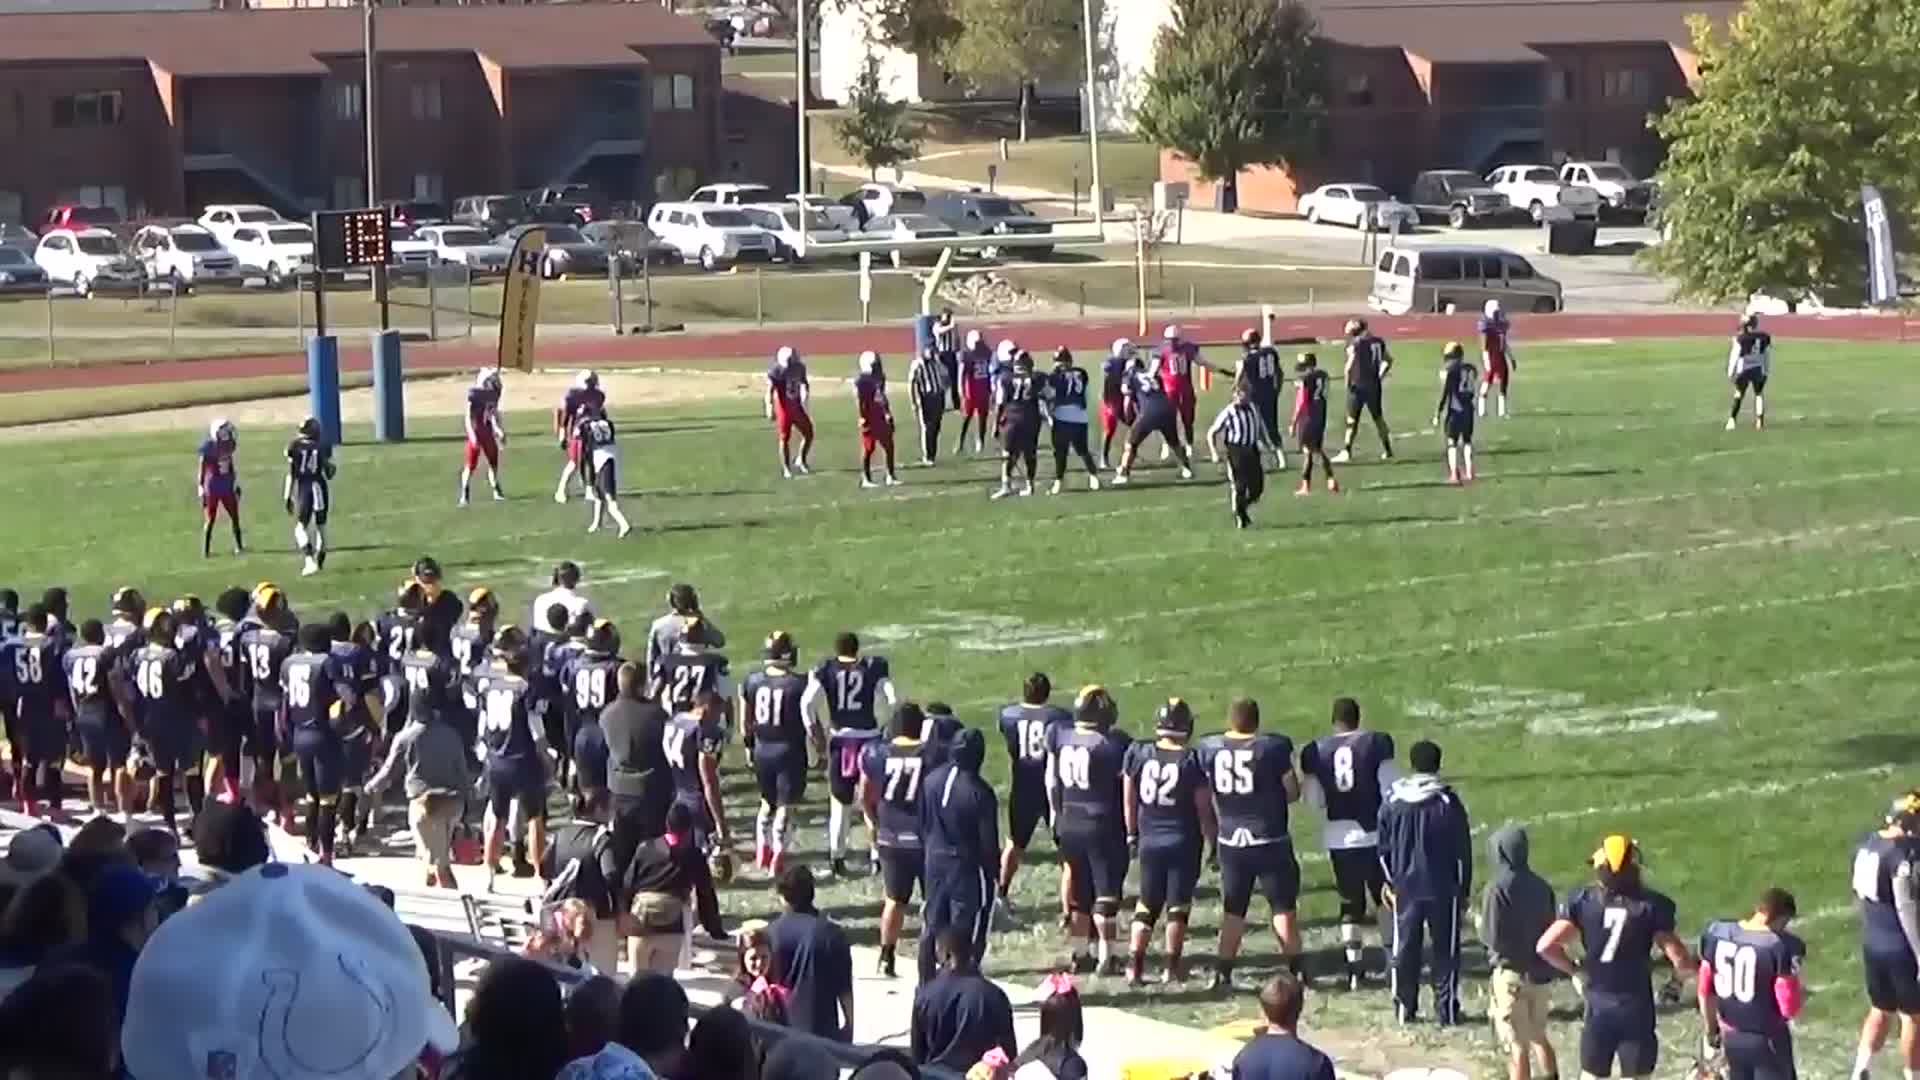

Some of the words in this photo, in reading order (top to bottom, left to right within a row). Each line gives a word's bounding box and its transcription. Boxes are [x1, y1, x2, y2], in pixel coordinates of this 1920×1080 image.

[344, 213, 385, 264] 18
[300, 448, 318, 474] 14
[15, 647, 43, 684] 58
[71, 656, 98, 694] 42
[136, 659, 163, 699] 46
[248, 643, 271, 680] 13
[575, 668, 606, 708] 99
[672, 664, 706, 703] 27
[836, 671, 865, 710] 12
[754, 686, 784, 727] 81
[1017, 719, 1045, 760] 18
[883, 757, 922, 802] 77
[1139, 759, 1179, 806] 62
[1214, 749, 1255, 794] 65
[1333, 745, 1355, 793] 8
[1600, 907, 1628, 963] 7
[1713, 940, 1757, 1003] 50
